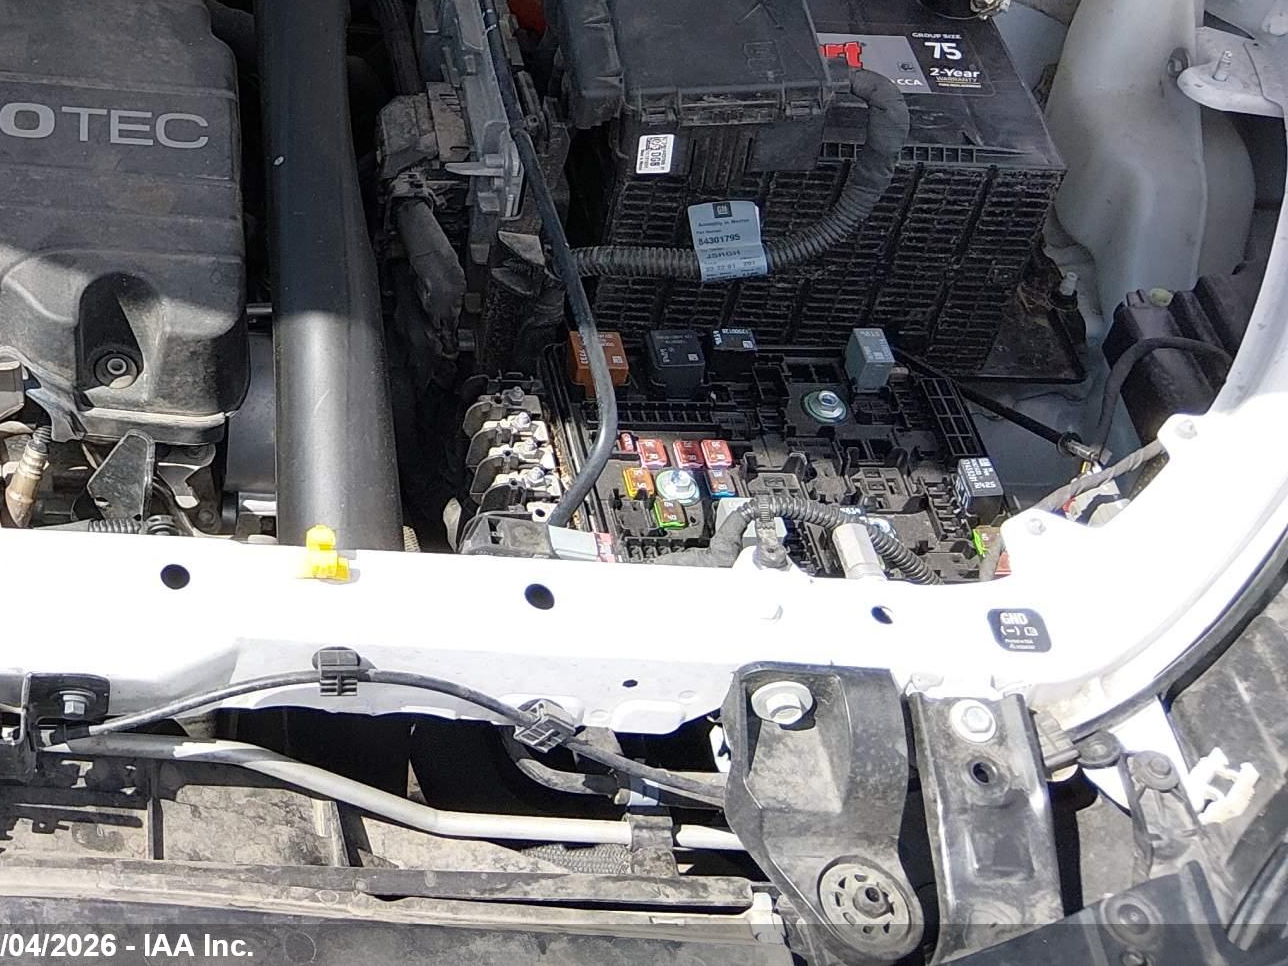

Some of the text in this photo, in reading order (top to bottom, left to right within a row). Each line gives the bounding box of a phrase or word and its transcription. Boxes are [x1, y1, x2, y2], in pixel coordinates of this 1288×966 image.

[924, 41, 963, 60] 75
[929, 67, 980, 78] 2-Year
[896, 78, 923, 86] CCA
[999, 612, 1028, 625] GND
